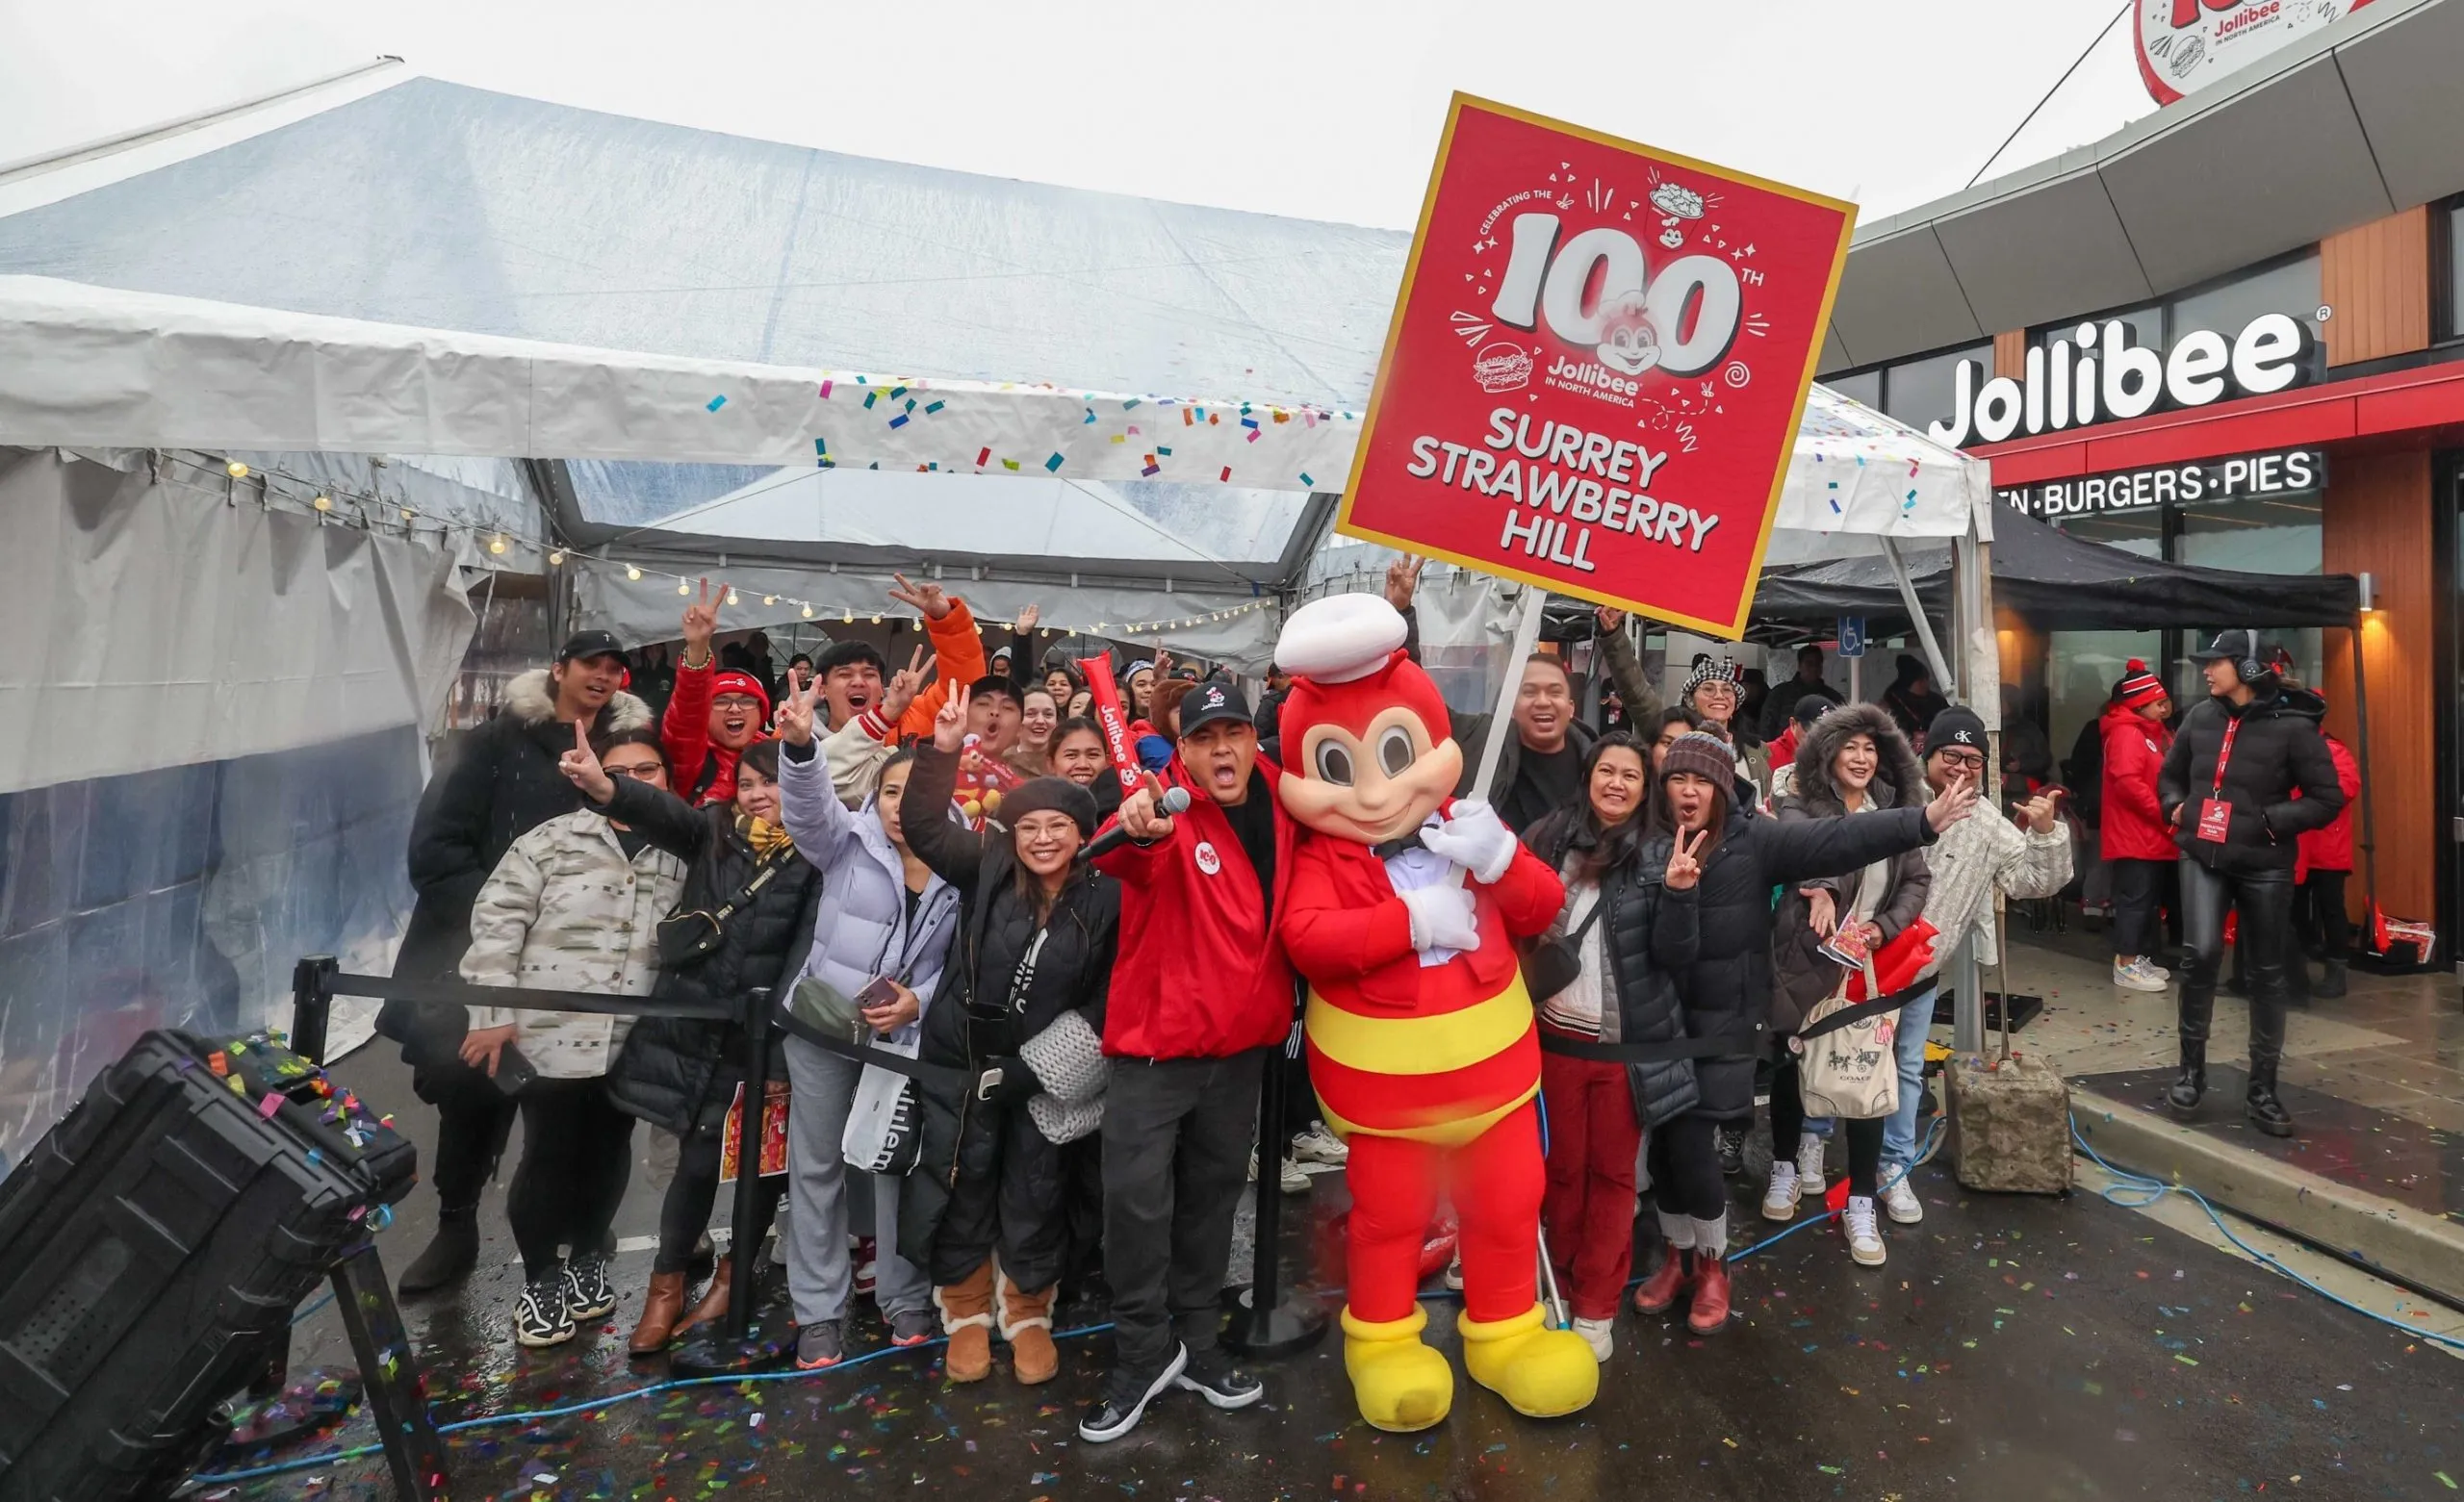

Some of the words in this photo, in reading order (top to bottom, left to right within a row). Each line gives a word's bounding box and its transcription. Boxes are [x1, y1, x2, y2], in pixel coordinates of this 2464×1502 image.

[2214, 1, 2280, 38] Jollibee
[2223, 29, 2247, 43] NORTH
[2248, 14, 2280, 33] AMERICA
[1479, 191, 1531, 236] CELEBRATING
[1532, 190, 1553, 199] THE
[1491, 213, 1741, 374] 100
[1741, 267, 1764, 287] TH
[1545, 376, 1556, 387] IN
[1557, 380, 1591, 396] NORTH
[1592, 390, 1634, 409] AMERICA
[1547, 355, 1640, 396] Jollibee
[1928, 313, 2302, 449] Jollibee
[1484, 407, 1667, 489] SURREY
[1406, 435, 1720, 552] STRAWBERRY
[2045, 467, 2202, 515] BURGERS
[2224, 451, 2312, 495] PIES
[1500, 508, 1596, 573] HILL
[1101, 704, 1126, 762] Jollibee
